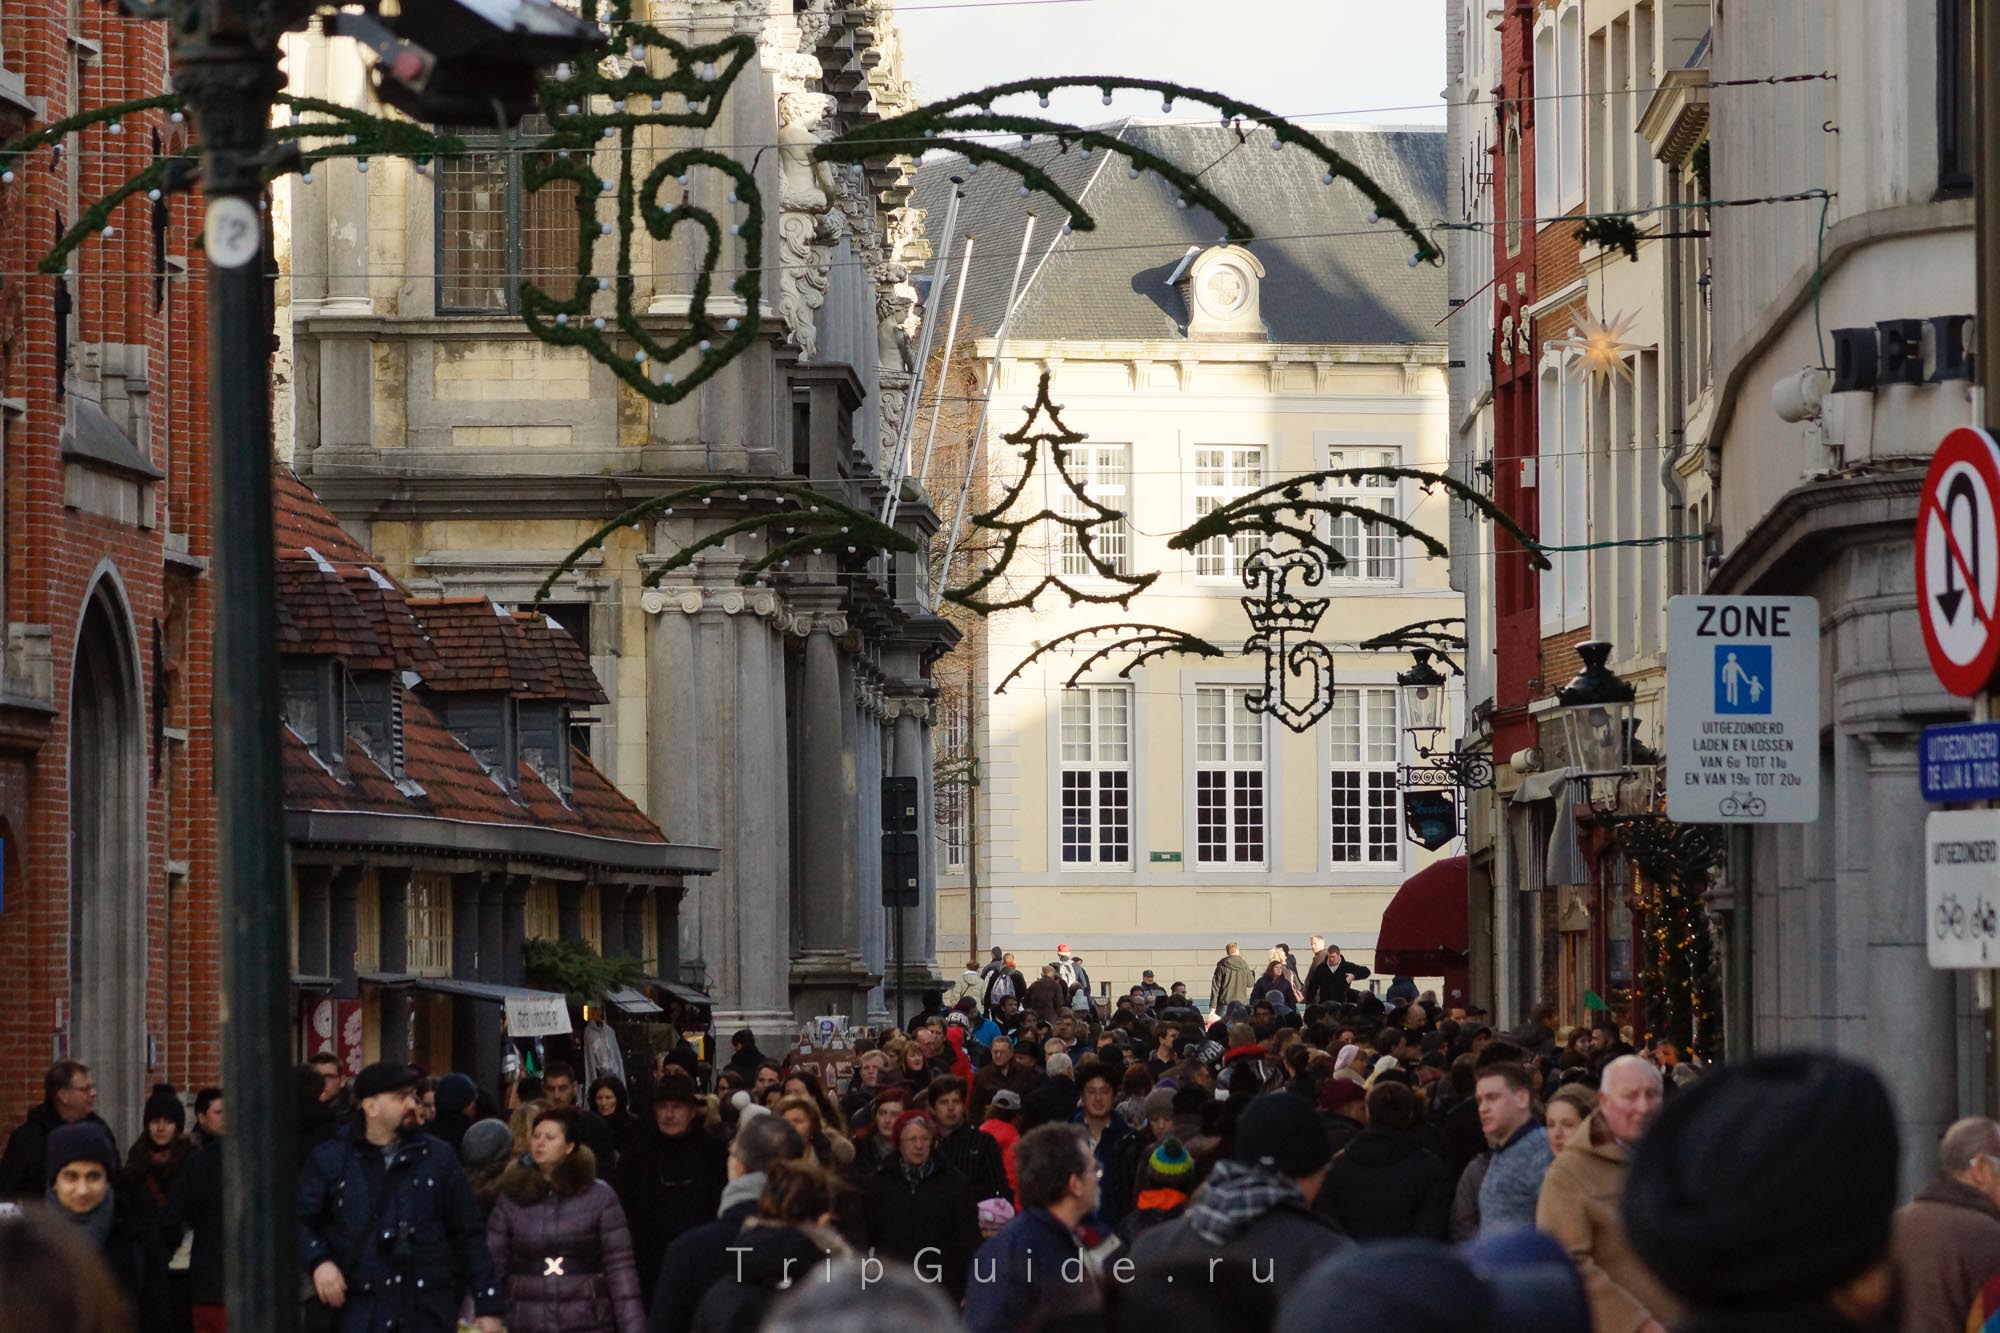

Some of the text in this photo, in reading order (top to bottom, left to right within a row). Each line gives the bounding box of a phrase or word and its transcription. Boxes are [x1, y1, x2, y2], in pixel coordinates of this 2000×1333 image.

[1696, 605, 1791, 638] ZONE
[1702, 721, 1785, 736] UITGEZONDERD
[1692, 739, 1794, 752] LADEN EN LOSSEN
[1700, 756, 1723, 769] VAN
[1746, 756, 1765, 769] TOT
[1685, 773, 1699, 786] EN
[1704, 773, 1727, 786] VAN
[1755, 772, 1775, 786] TOT
[1927, 765, 1941, 791] DE
